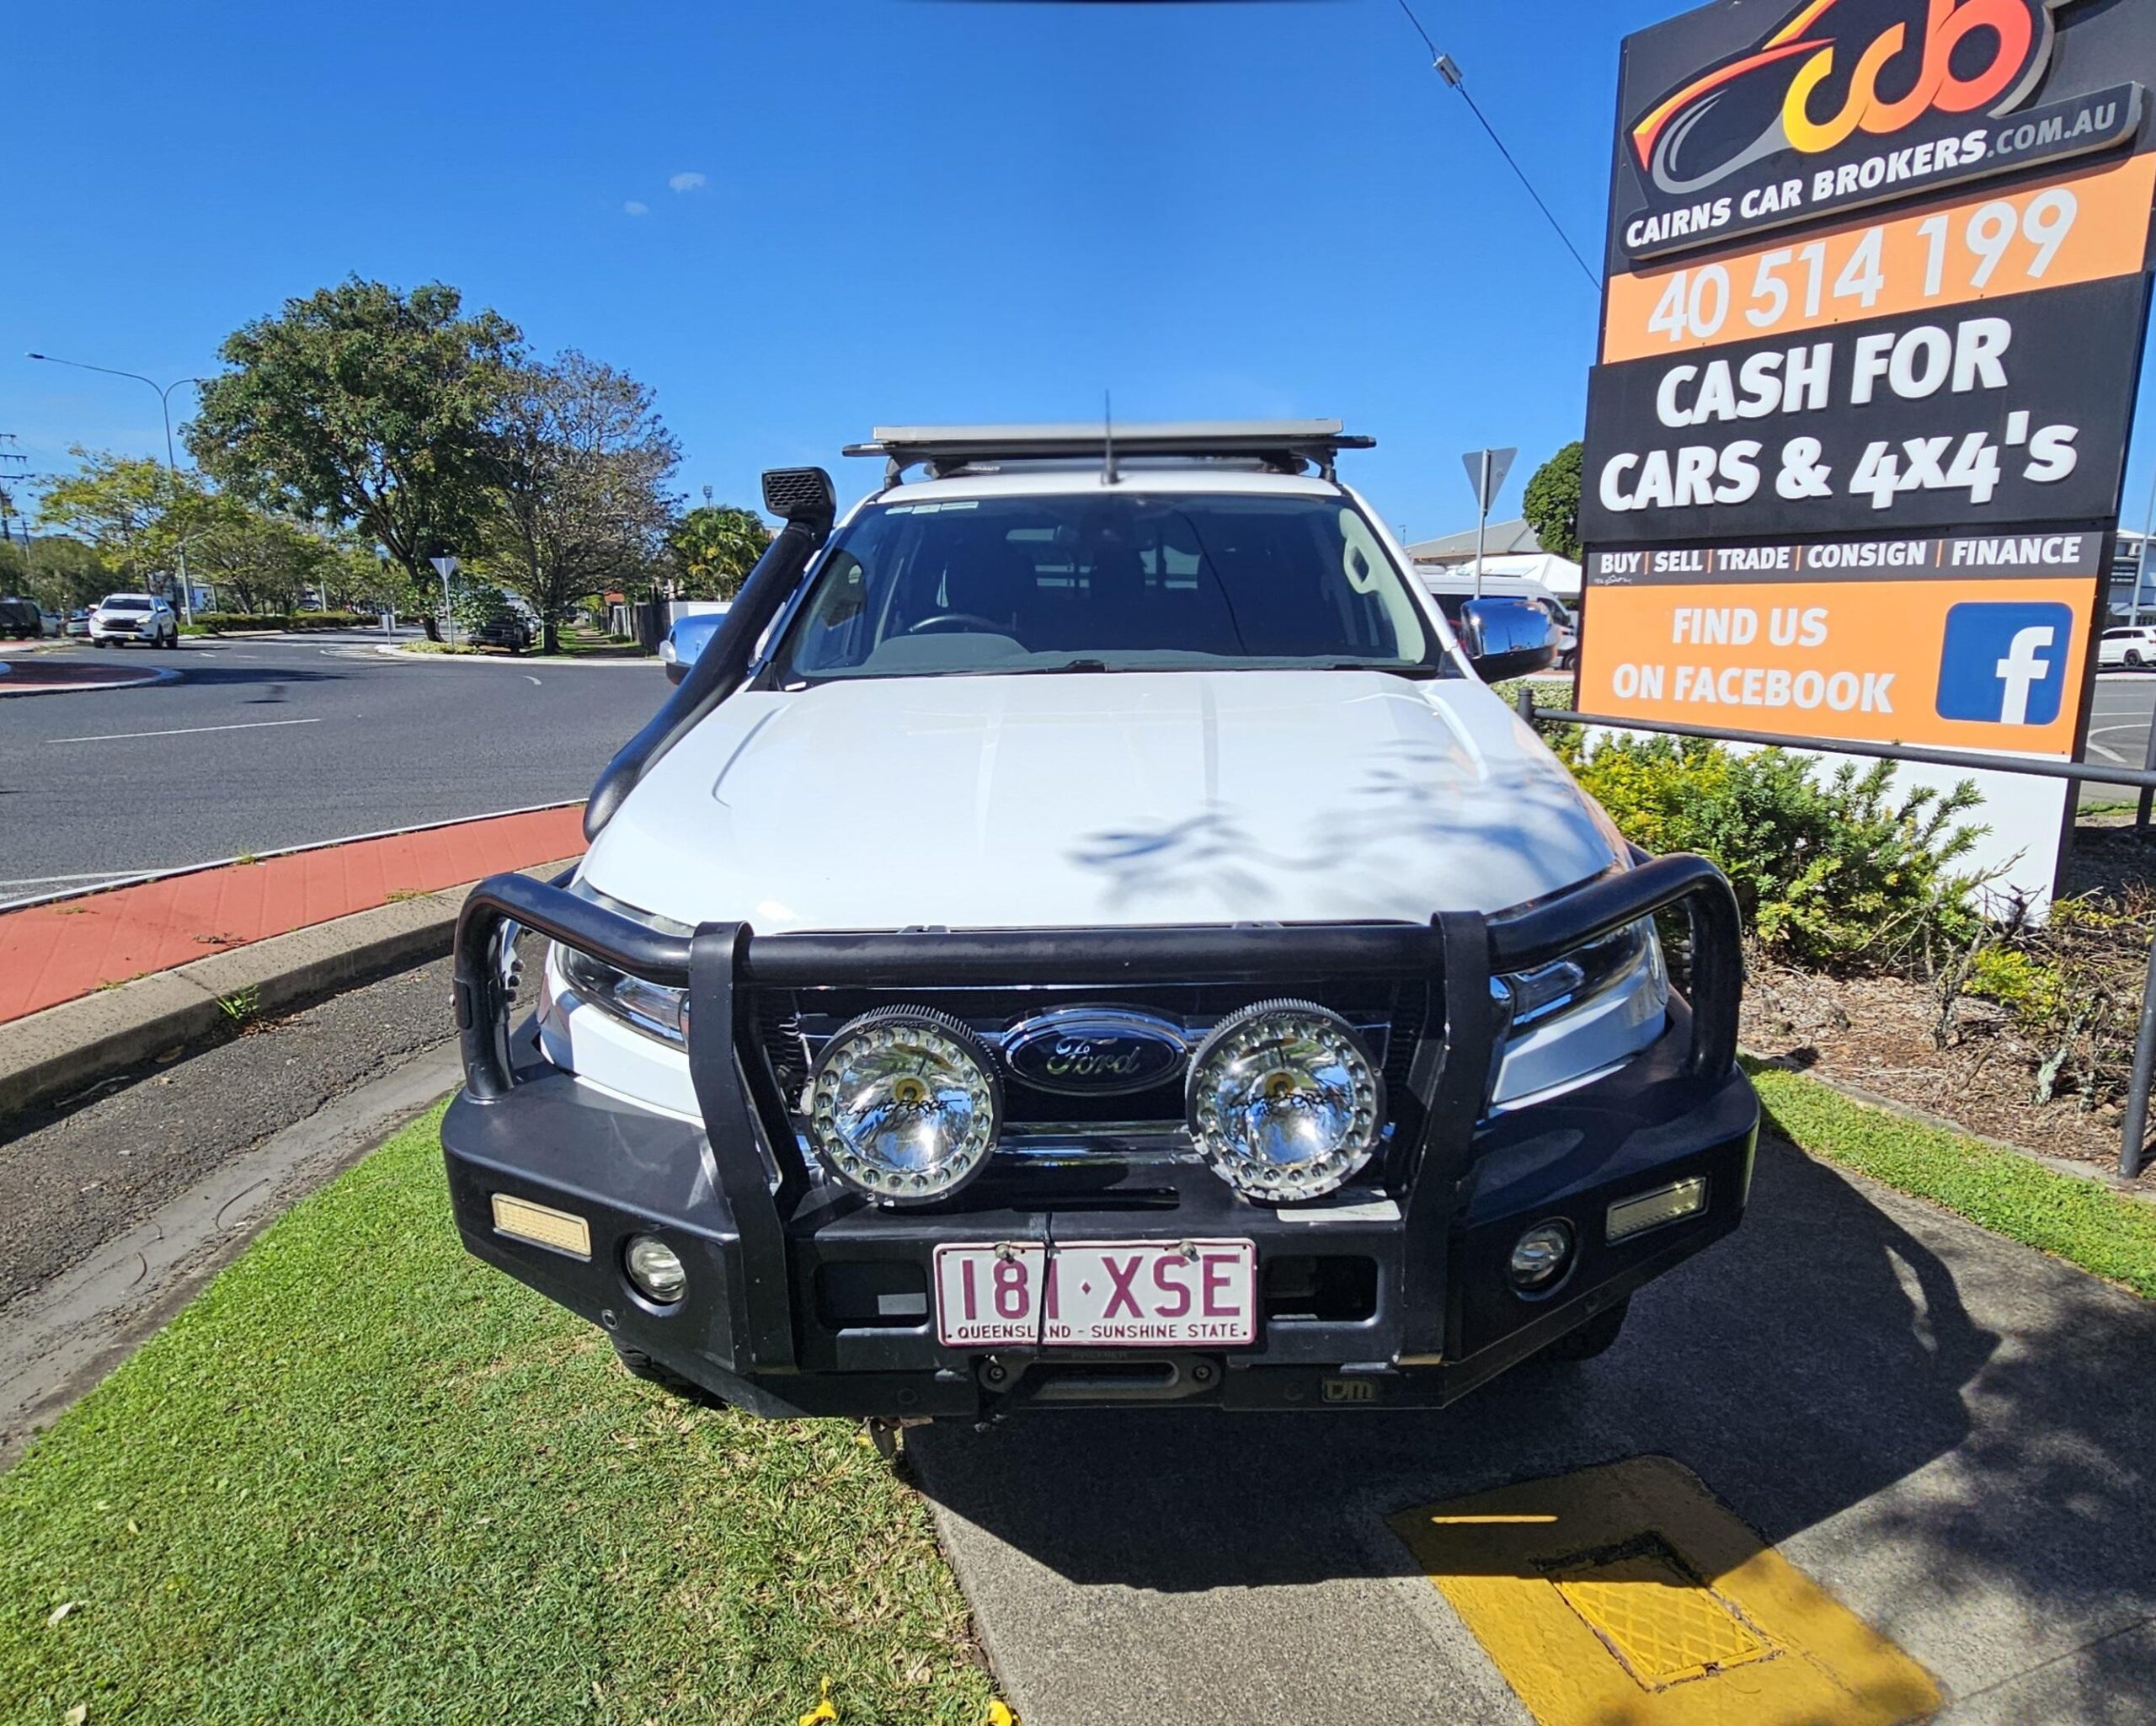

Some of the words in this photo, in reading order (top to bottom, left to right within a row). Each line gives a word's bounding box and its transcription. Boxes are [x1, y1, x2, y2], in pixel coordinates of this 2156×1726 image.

[1626, 198, 1731, 248] CAIRNS
[1741, 179, 1803, 219] CAR
[1647, 264, 1730, 343] 40
[1745, 226, 1884, 328] 514
[1918, 188, 2078, 297] 199
[1657, 341, 1833, 428] CASH
[1850, 318, 2012, 404] FOR
[1599, 440, 1763, 512] CARS
[1775, 436, 1833, 500] &
[1600, 553, 1641, 574] BUY
[1653, 550, 1703, 572] SELL
[1718, 546, 1790, 571] TRADE
[1806, 542, 1926, 569] CONSIGN
[1951, 536, 2082, 566] FINANCE
[1672, 607, 1758, 645] FIND
[1769, 607, 1829, 646] US
[1613, 663, 1664, 701] ON
[1673, 666, 1896, 714] FACEBOOK
[1046, 1036, 1141, 1075] Ford
[962, 1258, 1059, 1321] 181
[1101, 1254, 1241, 1320] XSE
[958, 1325, 1071, 1339] QUEENSLND
[1091, 1325, 1177, 1339] SUNSHINE
[1187, 1323, 1240, 1338] STATE
